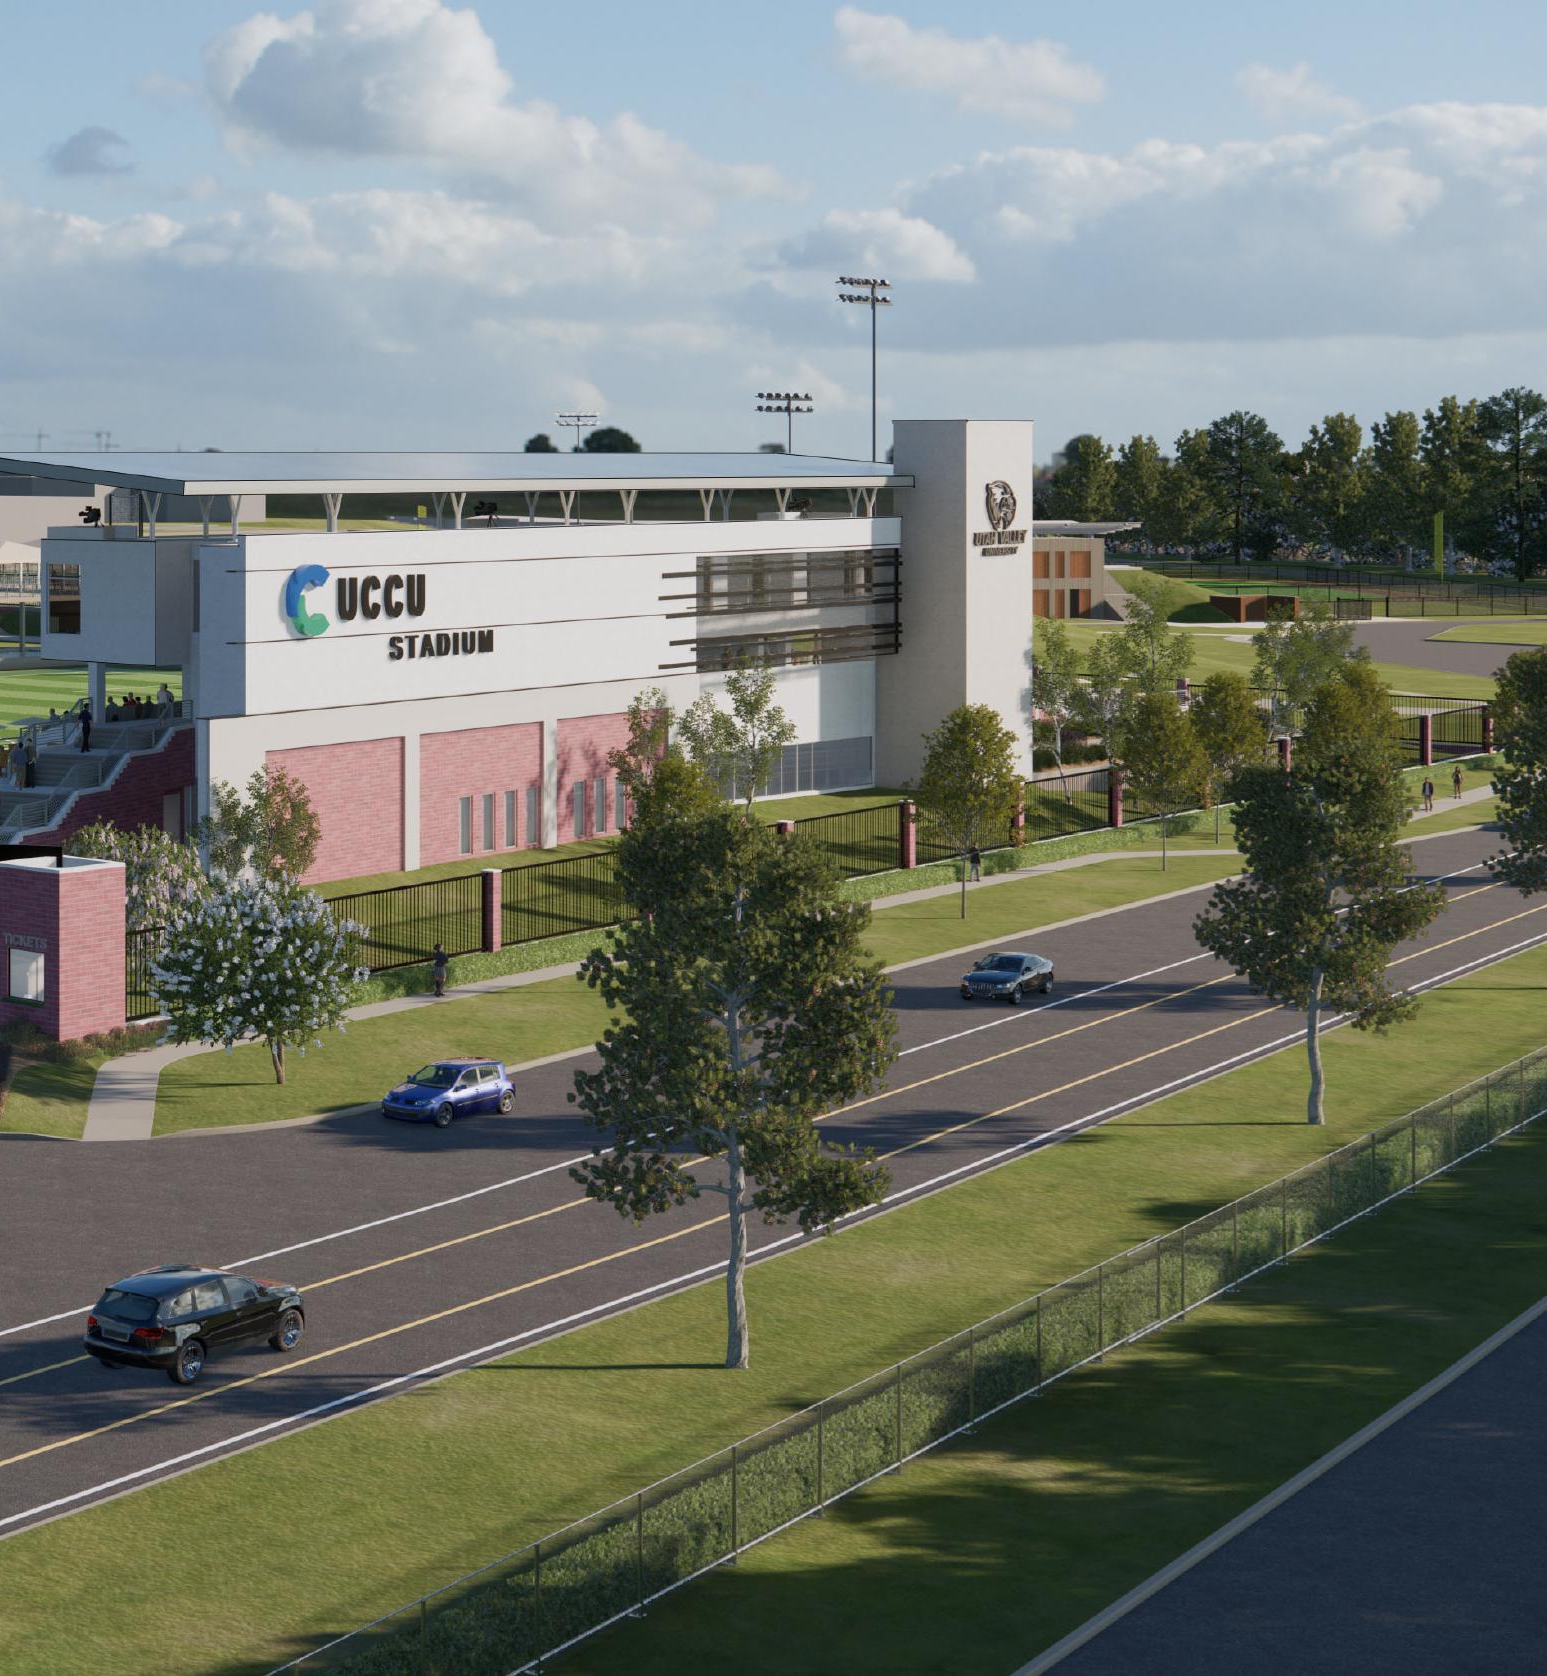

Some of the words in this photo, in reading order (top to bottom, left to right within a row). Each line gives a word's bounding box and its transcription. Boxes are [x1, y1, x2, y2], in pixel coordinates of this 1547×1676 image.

[973, 532, 996, 546] UTAH
[337, 573, 426, 621] UCCU
[388, 629, 494, 660] STADIUM
